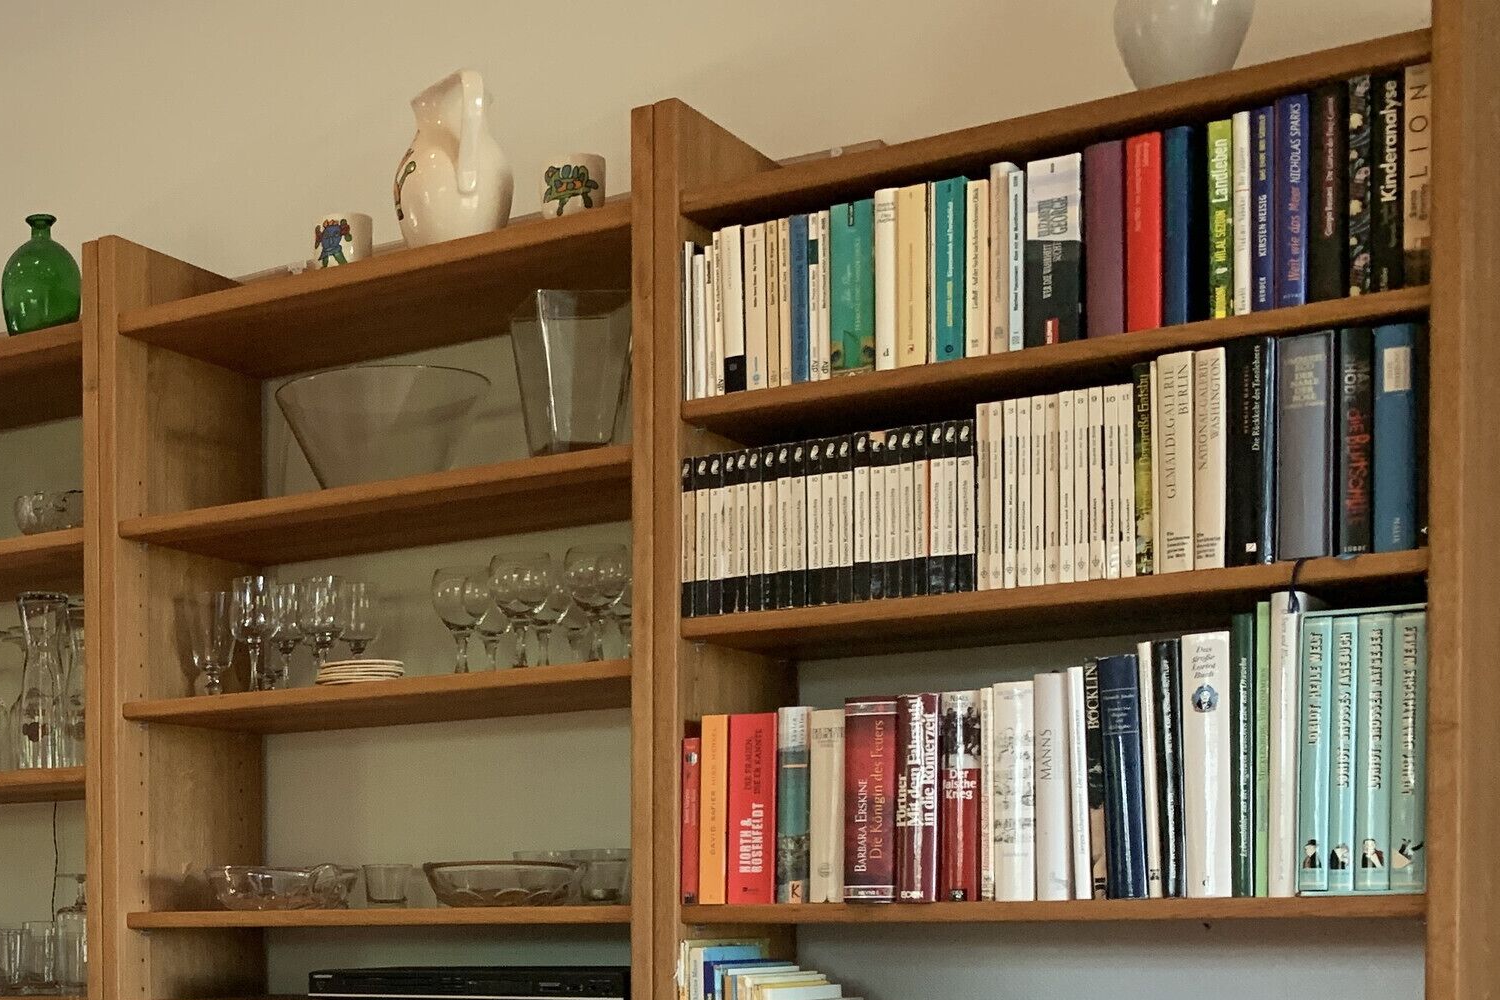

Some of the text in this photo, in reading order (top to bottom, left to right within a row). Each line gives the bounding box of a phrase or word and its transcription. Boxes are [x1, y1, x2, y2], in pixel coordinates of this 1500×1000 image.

[1290, 103, 1302, 183] NICHOLAS SPARKS
[1380, 80, 1402, 202] Kinderanalyse
[1408, 84, 1428, 178] LION
[1212, 139, 1228, 203] Landleben
[1049, 196, 1068, 235] GEORGE
[1287, 187, 1301, 212] Meer
[1258, 194, 1267, 257] KIRSTEN HEISIG
[1287, 216, 1301, 234] das
[1289, 238, 1300, 254] wie
[1287, 259, 1301, 280] Weit
[1042, 286, 1053, 298] WER
[810, 360, 818, 372] dtv
[1138, 374, 1151, 412] Gatsby
[1177, 364, 1188, 414] BERLIN
[1210, 358, 1220, 438] WASHINGTON
[1250, 402, 1261, 436] Rückkehr
[1250, 438, 1261, 450] Die
[1308, 632, 1322, 663] WELT
[1337, 632, 1351, 688] TAGEBUCH
[1368, 628, 1382, 687] RATGEBER
[1308, 666, 1322, 699] HEILE
[1337, 692, 1351, 740] GROSSES
[1368, 690, 1382, 742] GROSSER
[754, 728, 762, 764] KANNTE
[908, 698, 922, 826] Mit dem Fahrstuhl
[743, 776, 752, 790] DIE
[754, 780, 762, 794] DIE
[870, 720, 885, 859] Die Königin des Feuers
[921, 712, 936, 826] in die Römerzeit
[739, 818, 751, 826] &
[896, 774, 907, 827] Pörtner
[752, 802, 764, 872] ROSENFELDT
